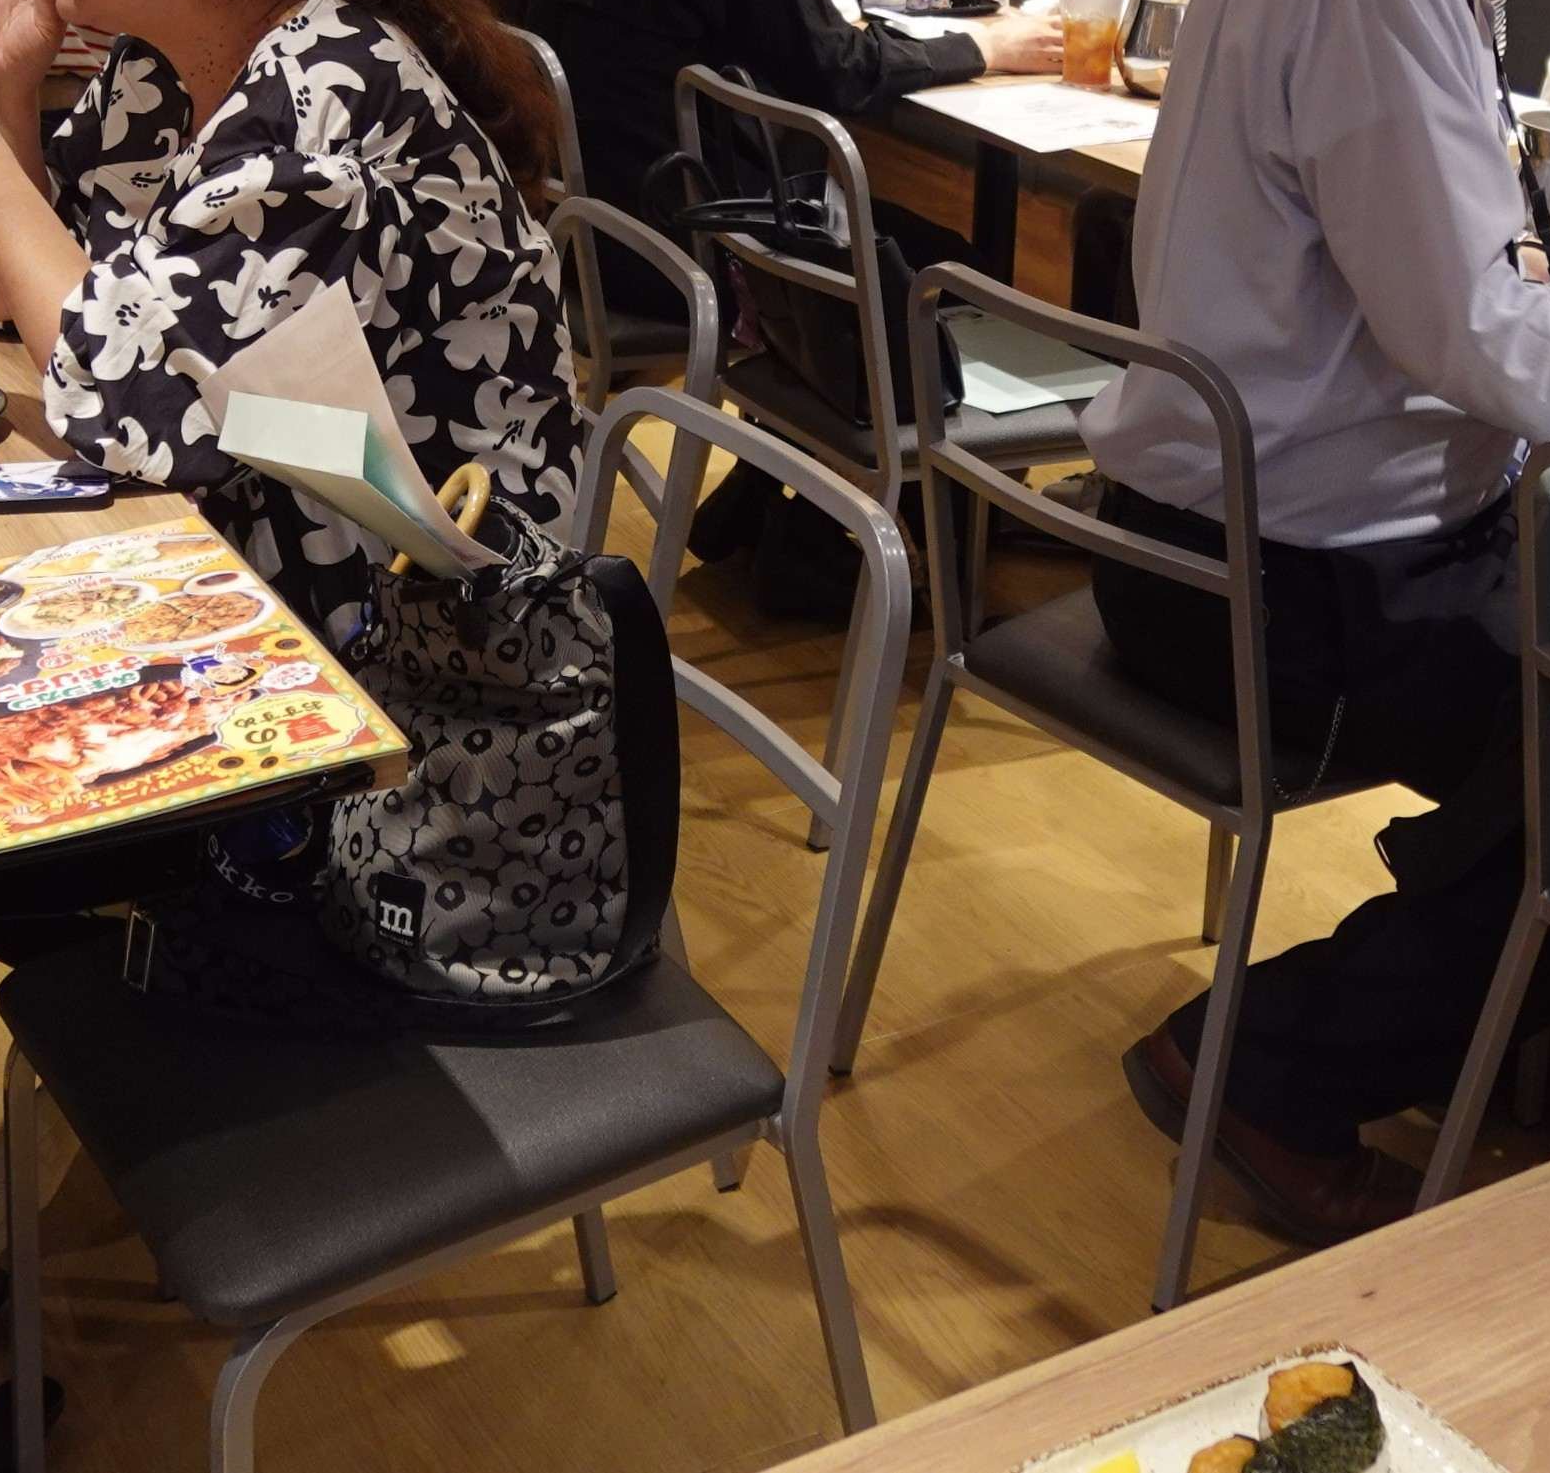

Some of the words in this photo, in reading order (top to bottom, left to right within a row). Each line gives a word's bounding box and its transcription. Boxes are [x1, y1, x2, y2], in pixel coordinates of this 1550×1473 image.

[228, 699, 327, 729] おすすめ
[235, 710, 340, 752] 夏の
[379, 900, 414, 937] m
